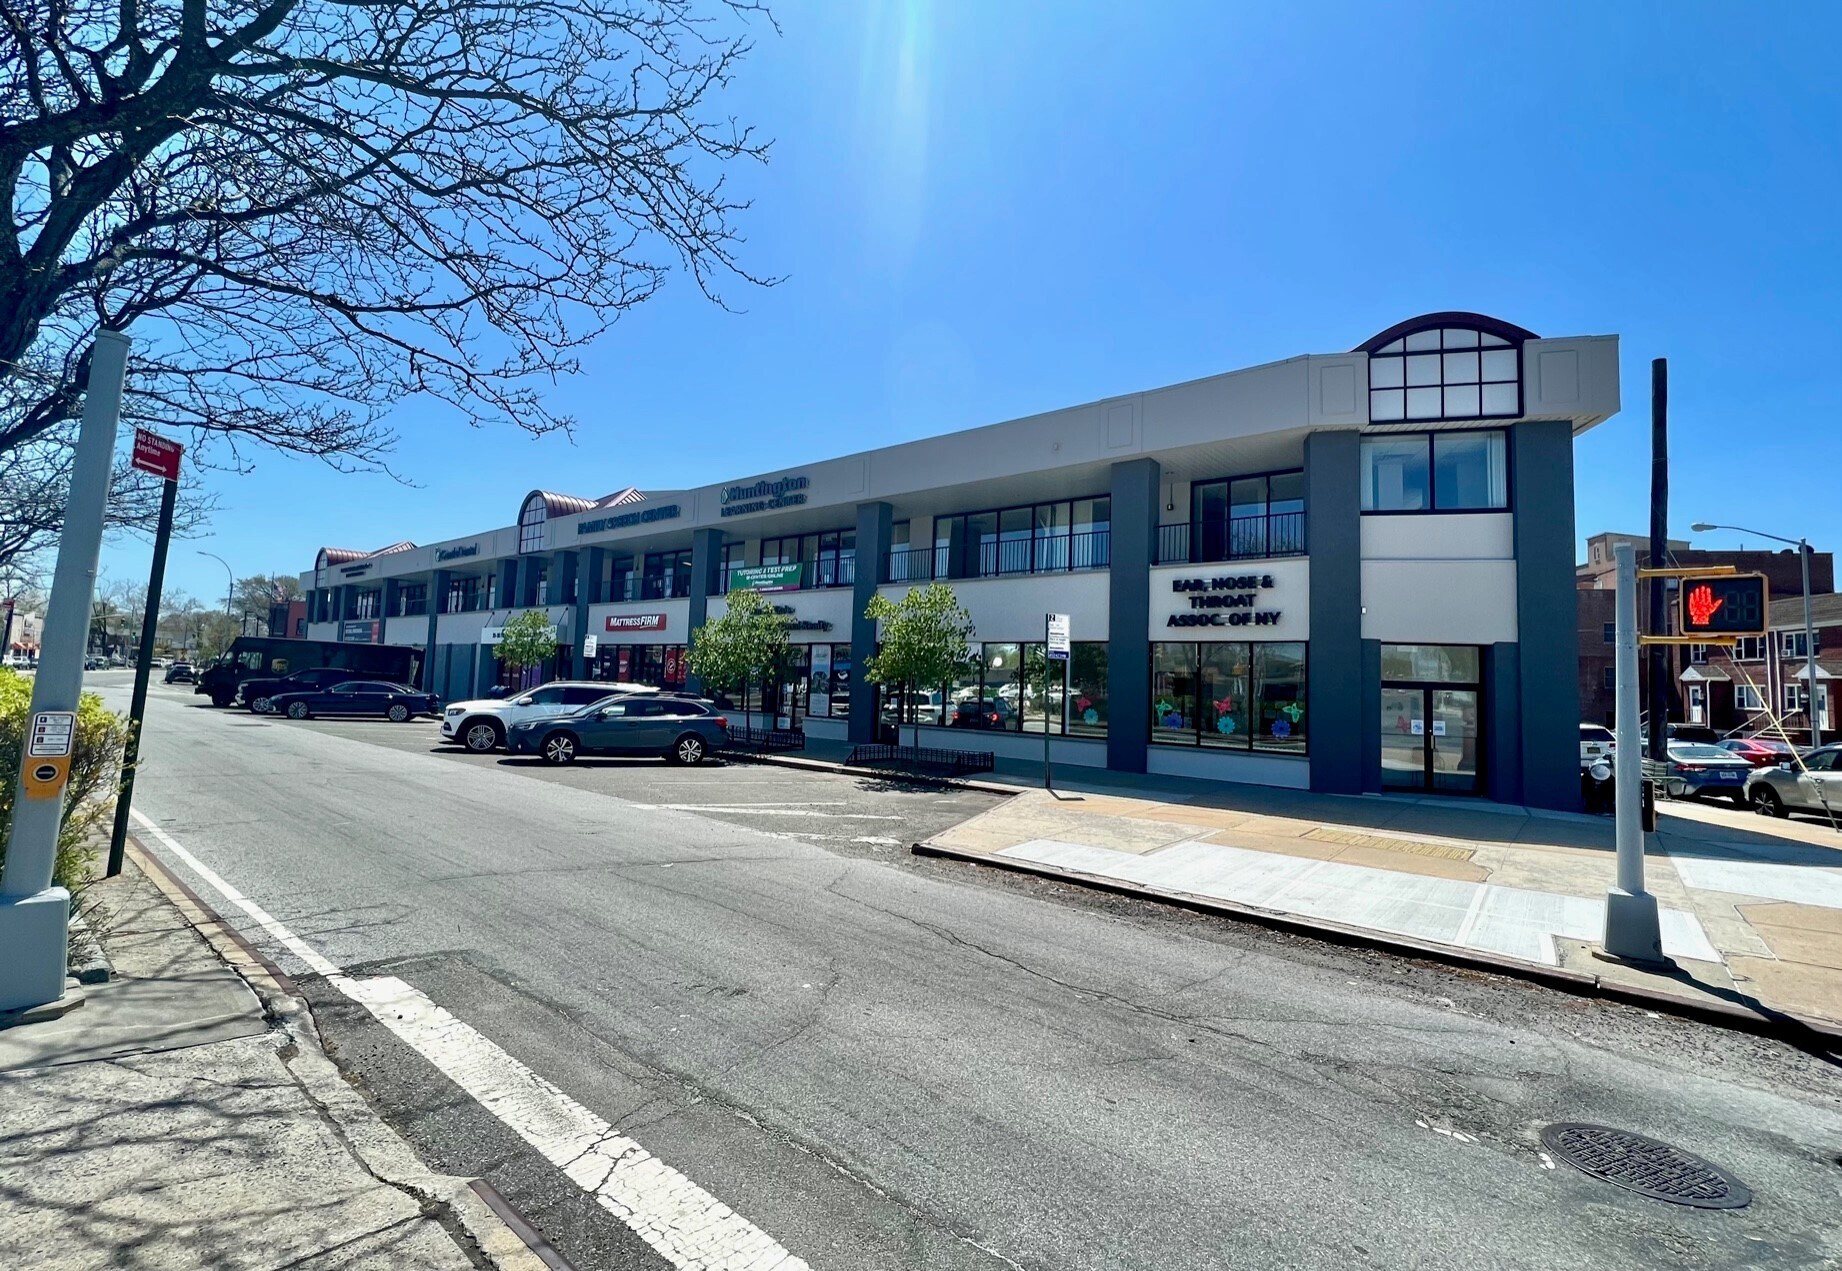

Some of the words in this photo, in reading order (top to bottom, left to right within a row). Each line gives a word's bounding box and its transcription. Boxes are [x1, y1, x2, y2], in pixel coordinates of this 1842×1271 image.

[137, 432, 147, 442] NO
[136, 442, 161, 457] Anytime
[729, 476, 810, 501] Huntington
[720, 500, 766, 518] LEARNING
[767, 493, 808, 510] CENTER
[640, 504, 682, 524] CENTER
[767, 565, 781, 574] TEST
[780, 564, 798, 573] PREP
[1172, 579, 1209, 593] EAR,
[1211, 575, 1258, 591] NOSE
[1261, 574, 1275, 589] &
[1188, 593, 1257, 609] THROAT
[1228, 612, 1252, 627] OF
[1254, 611, 1283, 626] NY
